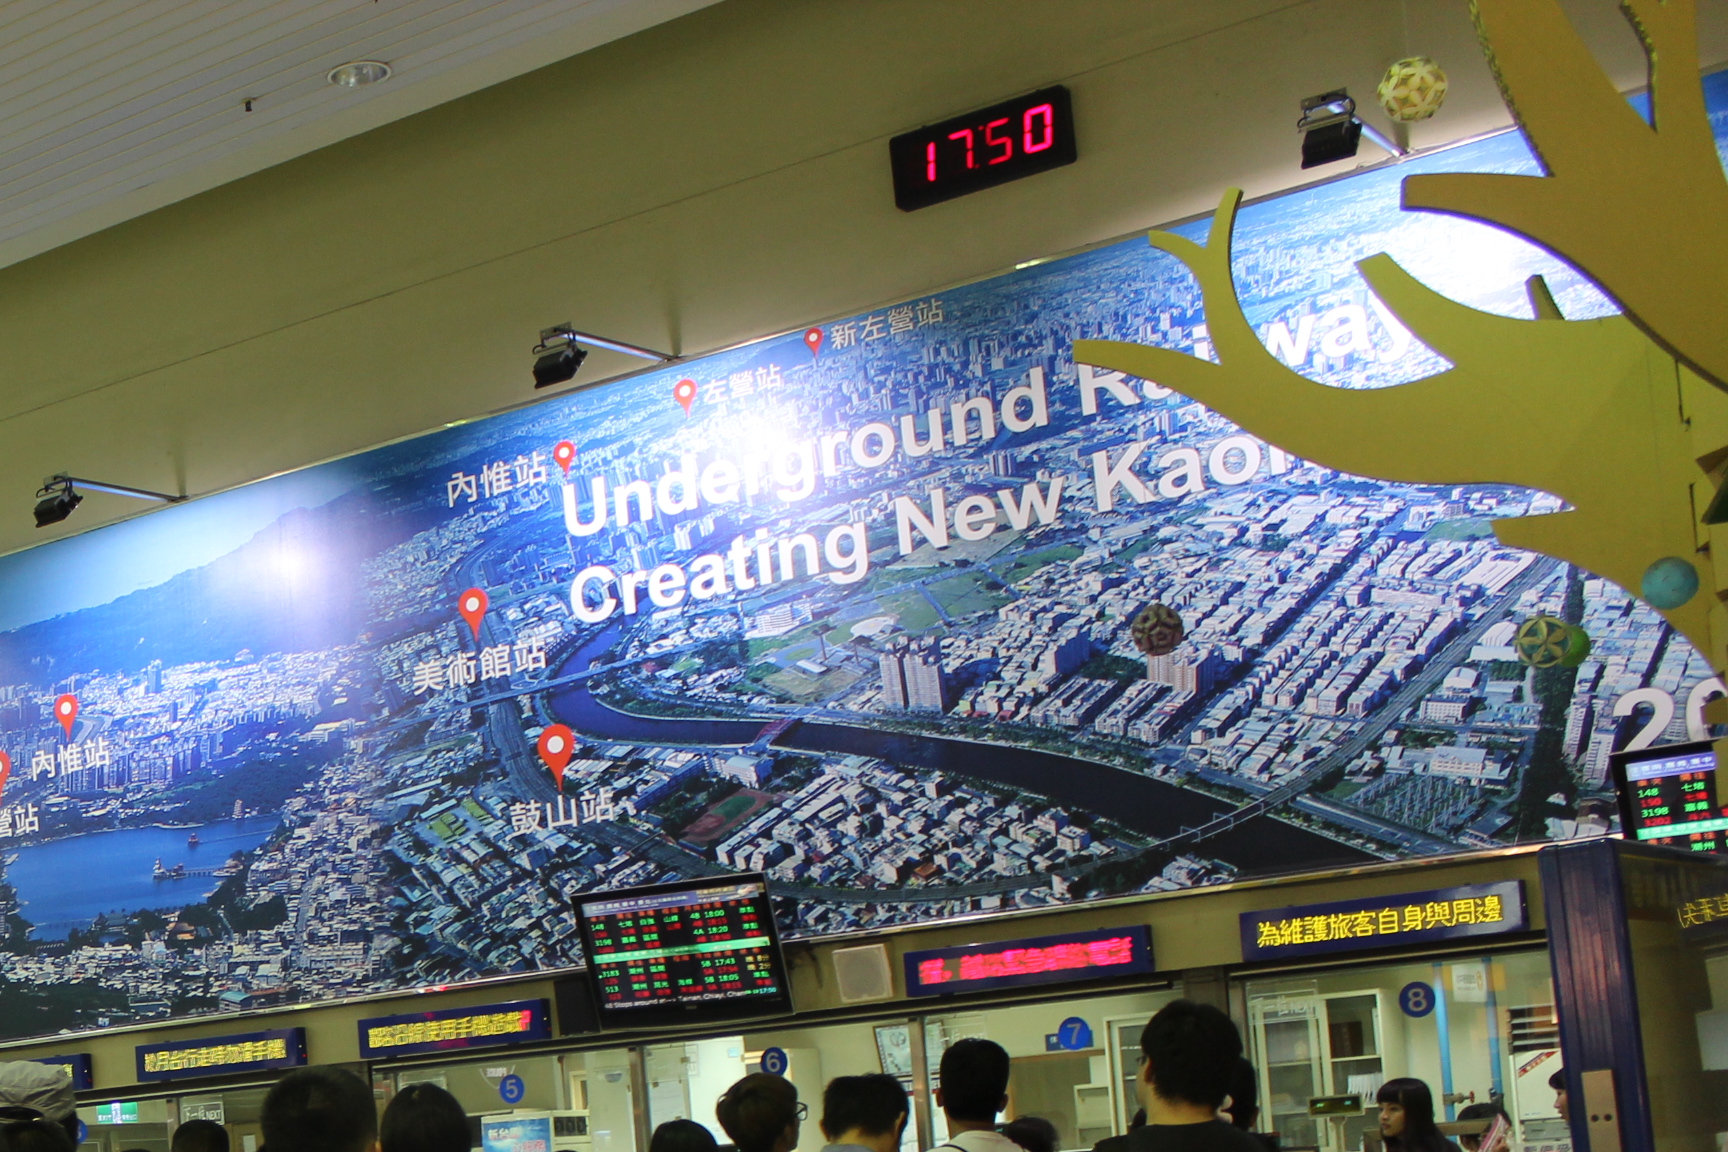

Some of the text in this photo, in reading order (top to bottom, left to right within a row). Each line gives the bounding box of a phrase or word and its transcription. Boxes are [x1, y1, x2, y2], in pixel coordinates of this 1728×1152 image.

[926, 102, 1054, 182] 17:50
[831, 298, 945, 350] 新左營站
[703, 364, 781, 404] 左營站
[561, 298, 1414, 538] Underground Riway
[446, 451, 549, 508] 內惟站
[569, 519, 870, 625] Creating
[894, 477, 1064, 557] New
[412, 640, 548, 696] 美術館站
[31, 739, 111, 783] 內惟站
[1637, 787, 1660, 799] 148
[509, 787, 618, 837] 鼓山站
[1641, 806, 1670, 818] 3198
[704, 909, 725, 918] 18:00
[707, 926, 729, 934] 18:20
[1256, 895, 1505, 948] 為維護旅客自身與周邊
[714, 957, 736, 966] 17:43
[718, 973, 740, 982] 18:05
[1406, 986, 1428, 1012] 8
[1065, 1022, 1082, 1046] 7
[766, 1052, 781, 1072] 6
[505, 1079, 518, 1099] 5
